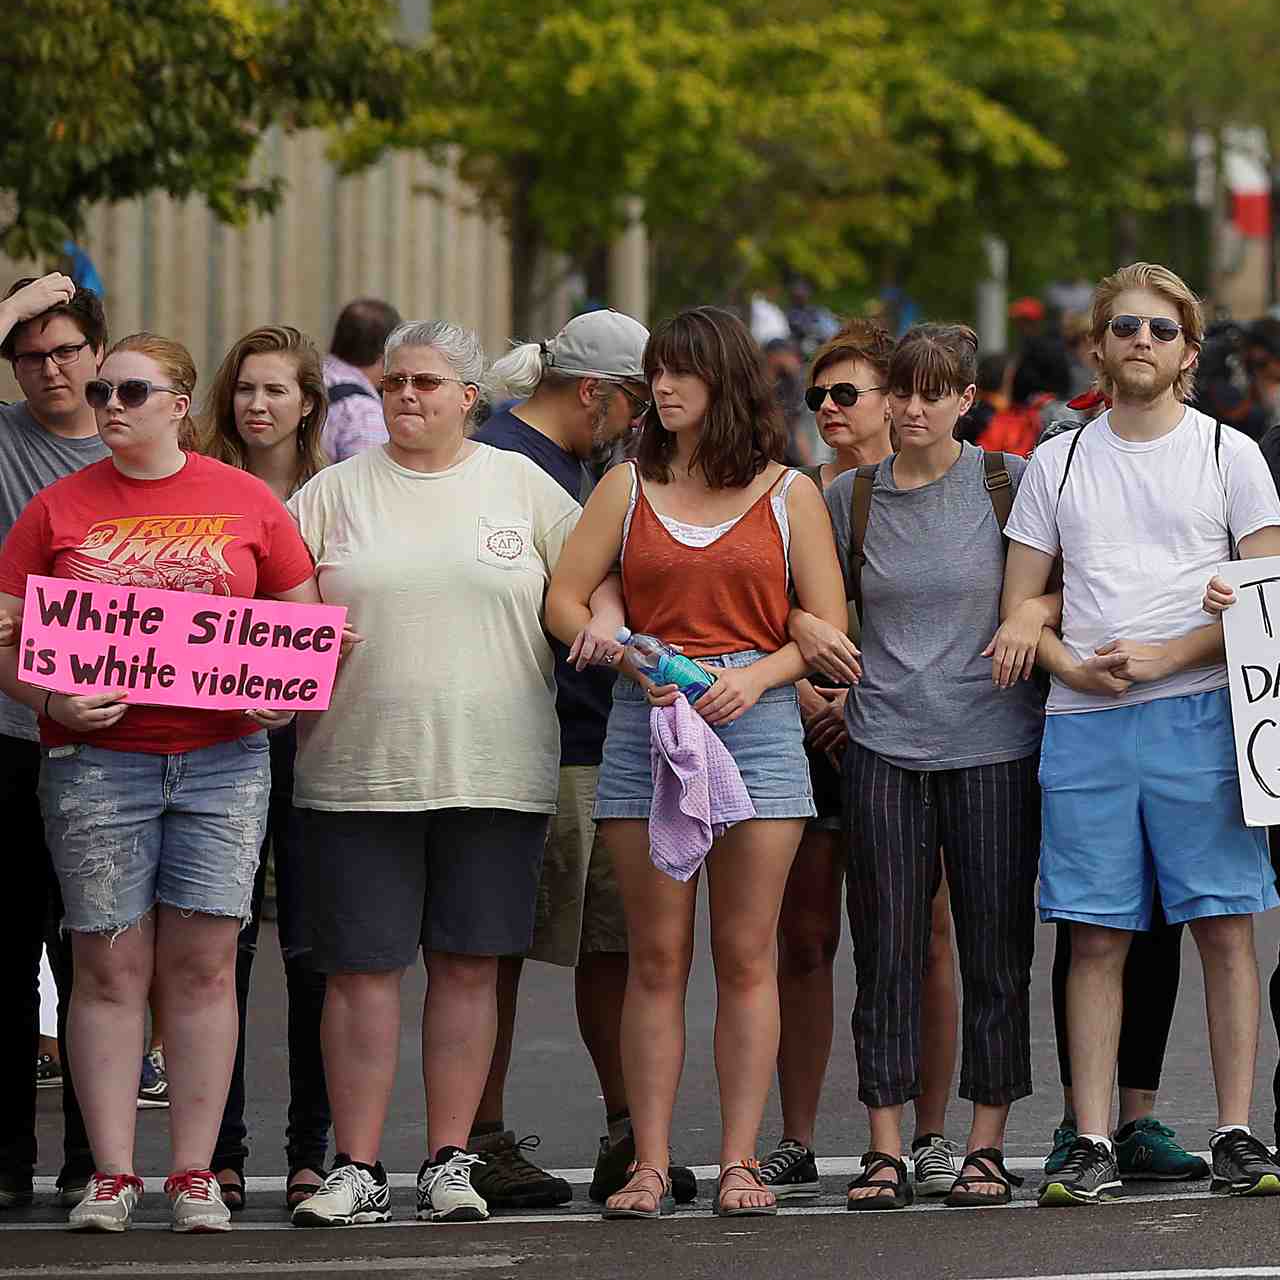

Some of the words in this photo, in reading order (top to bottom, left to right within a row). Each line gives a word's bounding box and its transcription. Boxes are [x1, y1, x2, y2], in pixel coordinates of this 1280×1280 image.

[108, 536, 240, 576] MAN
[36, 586, 164, 636] White
[23, 638, 56, 675] is
[191, 665, 318, 702] violence
